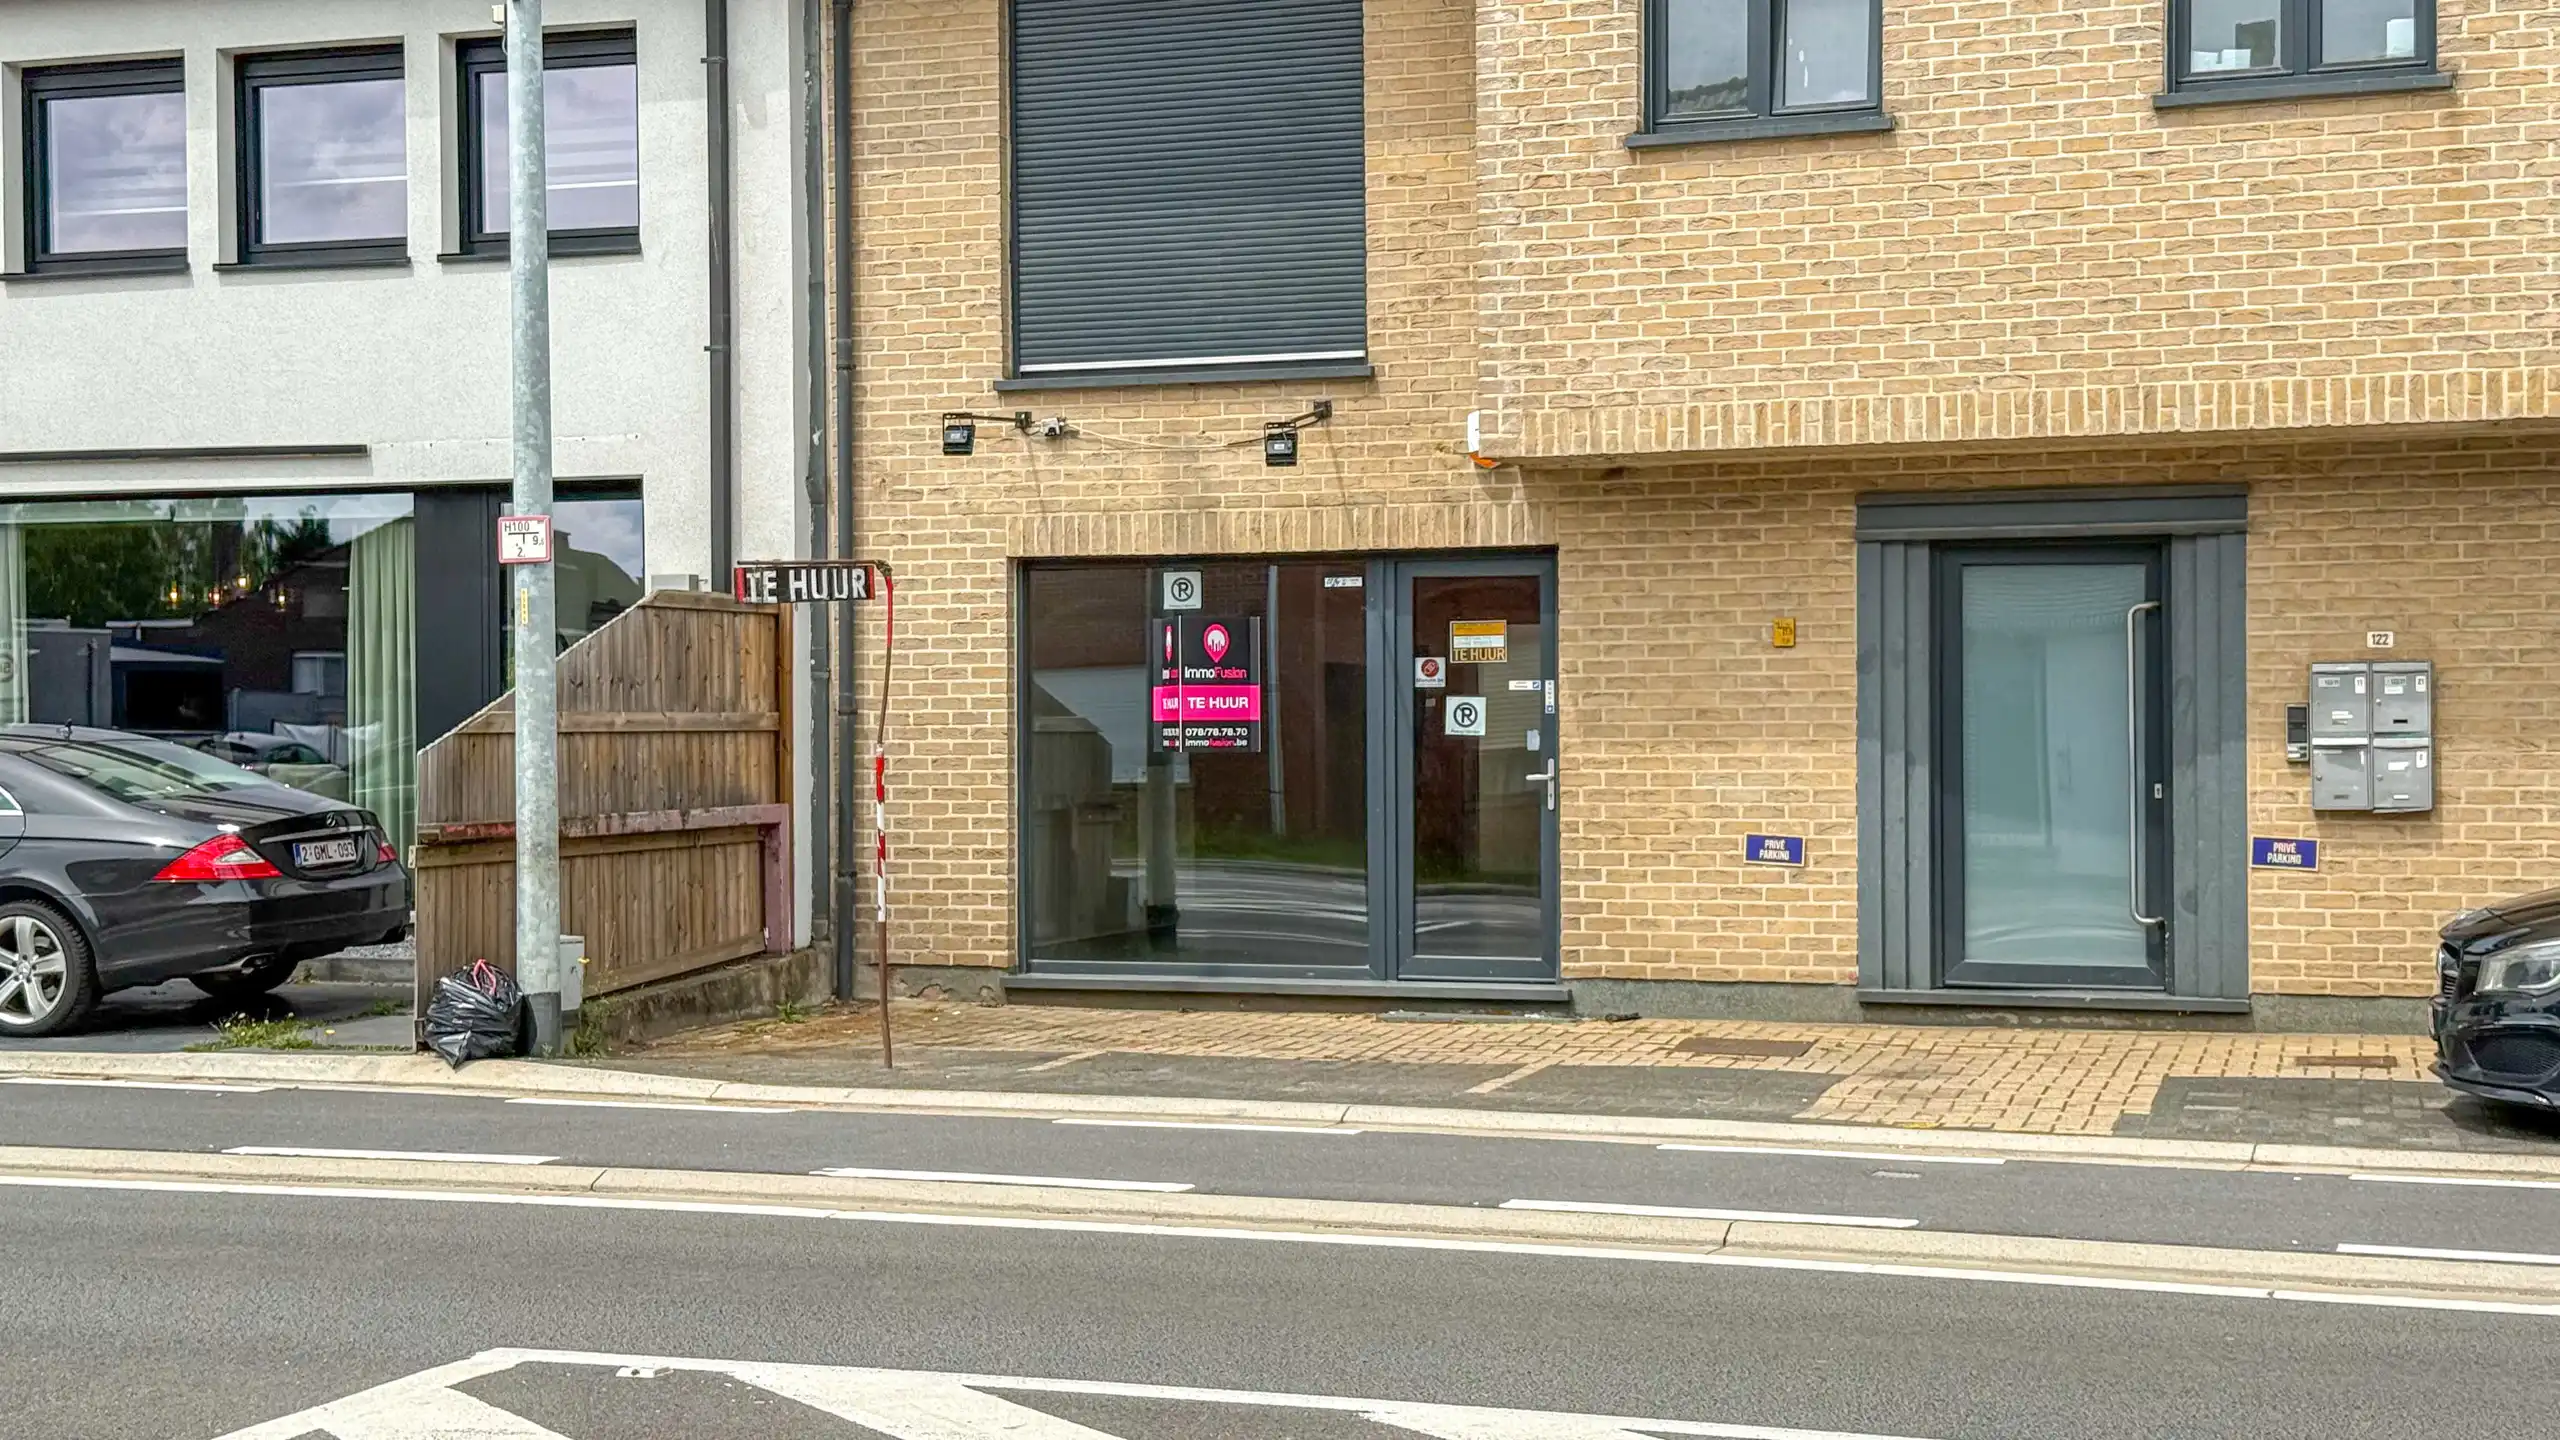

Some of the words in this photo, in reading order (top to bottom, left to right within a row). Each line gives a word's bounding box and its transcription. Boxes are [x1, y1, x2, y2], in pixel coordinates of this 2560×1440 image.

[504, 521, 530, 532] H100
[743, 570, 778, 603] TE
[789, 567, 867, 602] HUUR
[2371, 633, 2389, 646] 122
[1453, 648, 1468, 661] TE
[1470, 647, 1505, 661] HUUR
[1187, 697, 1206, 709] TE
[1209, 696, 1249, 709] HUUR
[2266, 852, 2302, 865] PARKING
